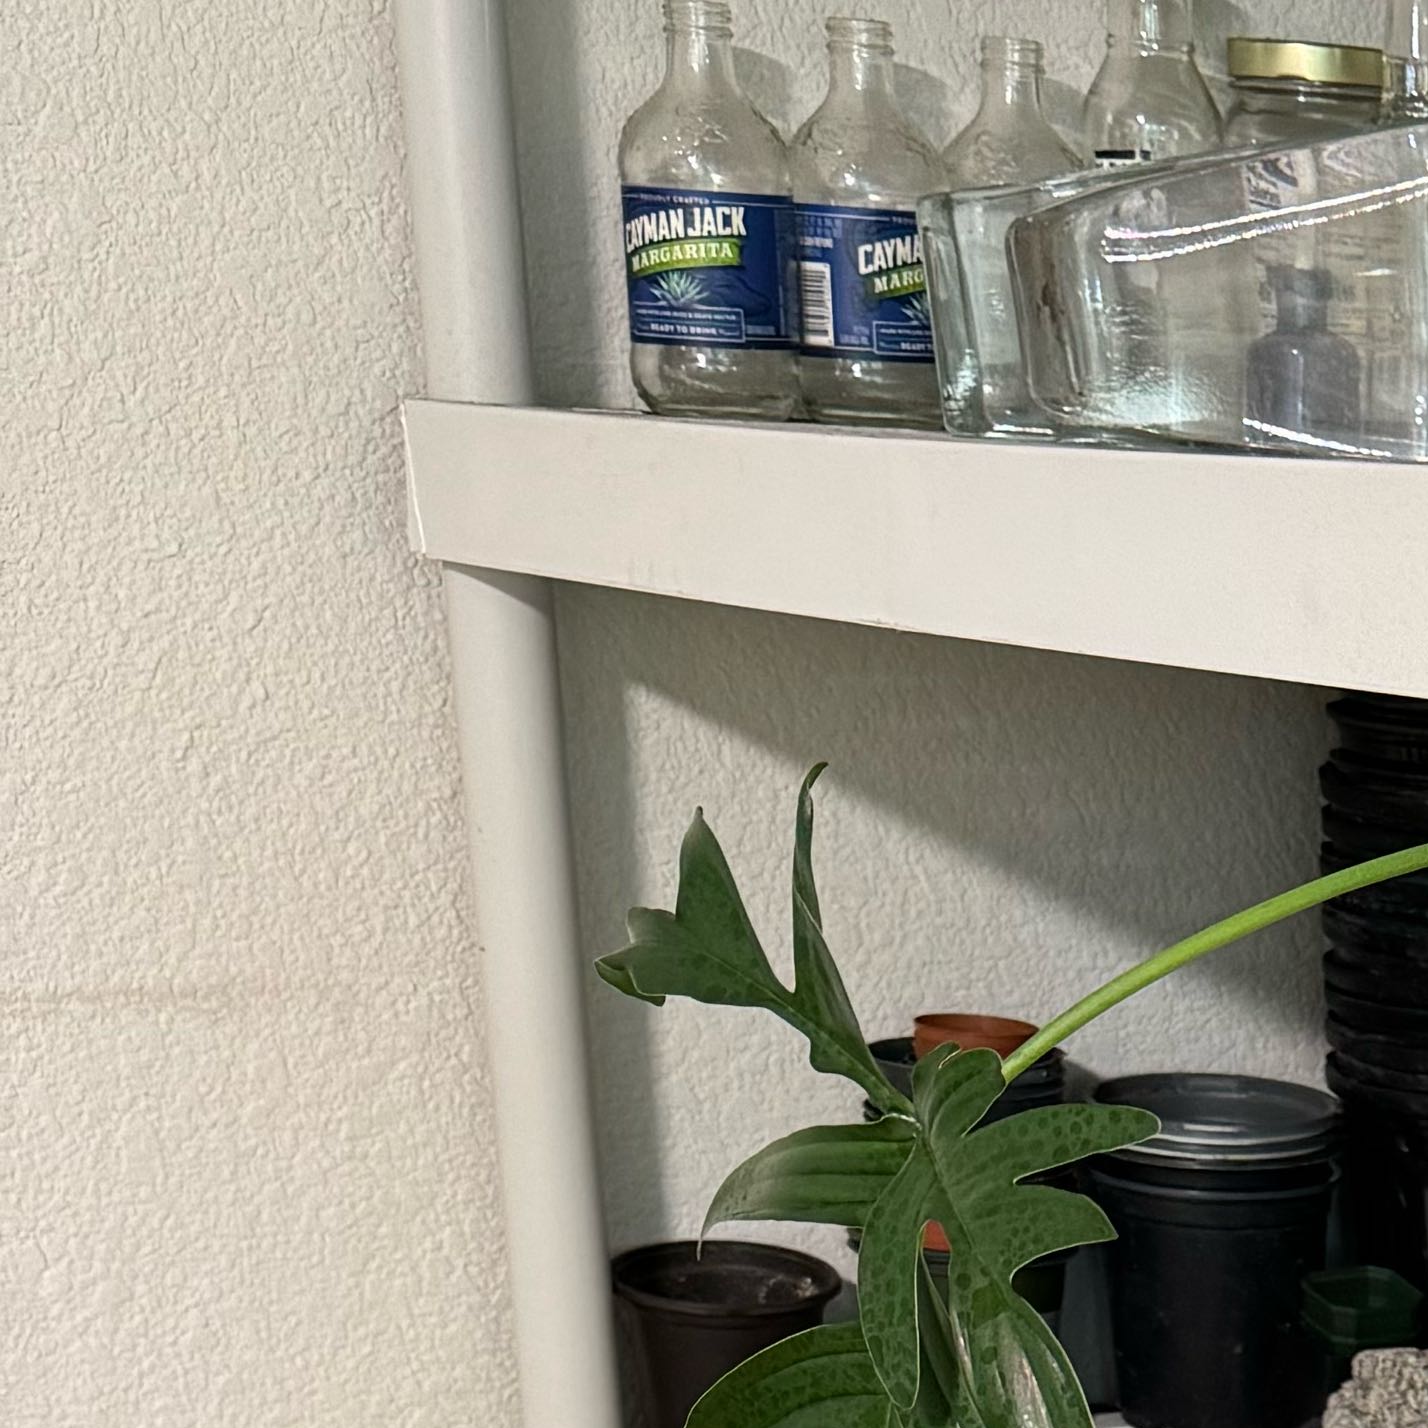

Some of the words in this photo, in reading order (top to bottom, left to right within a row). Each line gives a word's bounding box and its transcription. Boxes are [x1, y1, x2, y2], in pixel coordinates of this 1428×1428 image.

[626, 208, 686, 253] CAYMAN
[687, 206, 747, 237] JACK
[632, 242, 734, 272] MARGARITA
